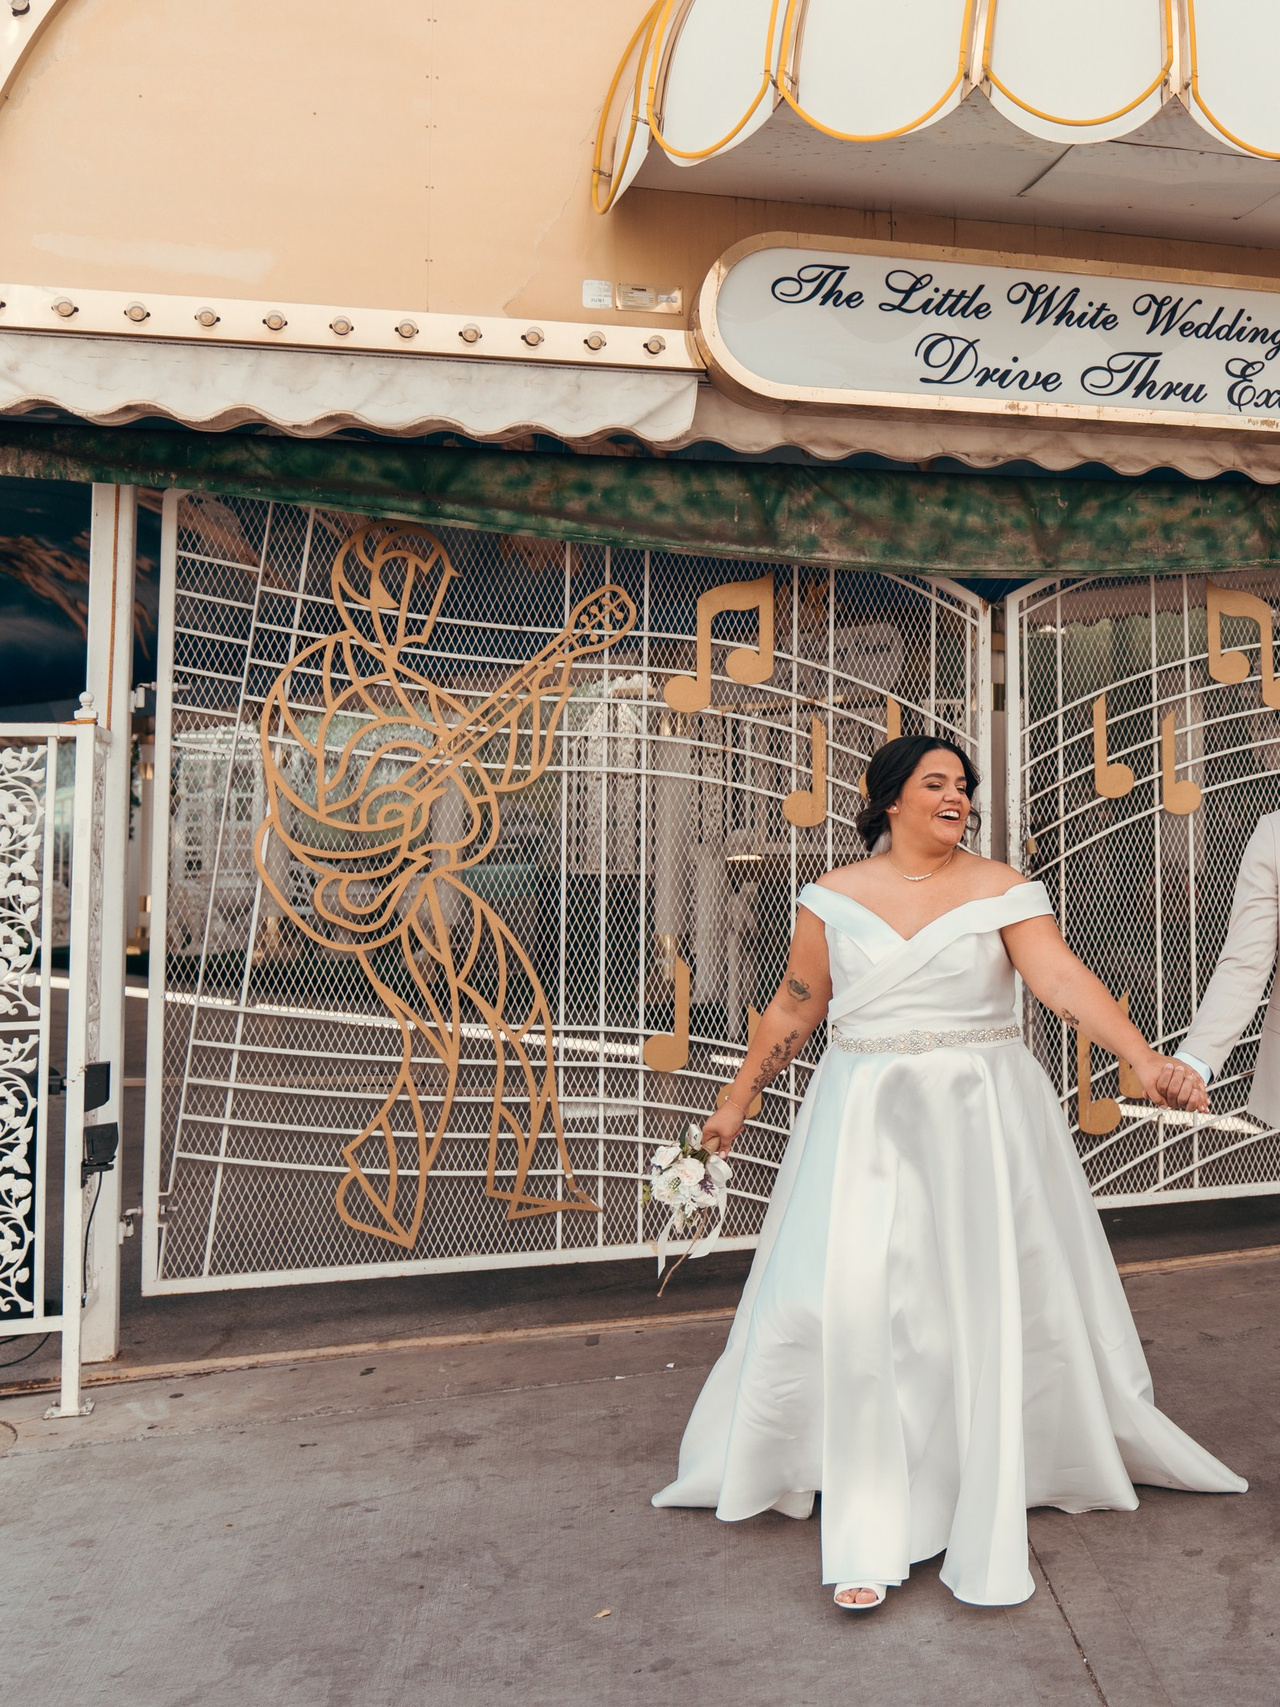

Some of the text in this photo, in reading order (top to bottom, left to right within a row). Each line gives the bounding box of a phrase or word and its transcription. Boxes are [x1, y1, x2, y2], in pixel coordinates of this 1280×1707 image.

[771, 264, 864, 309] The
[878, 270, 992, 319] Little
[1006, 282, 1119, 331] White
[914, 332, 1063, 393] Drive
[1080, 351, 1208, 404] Thru
